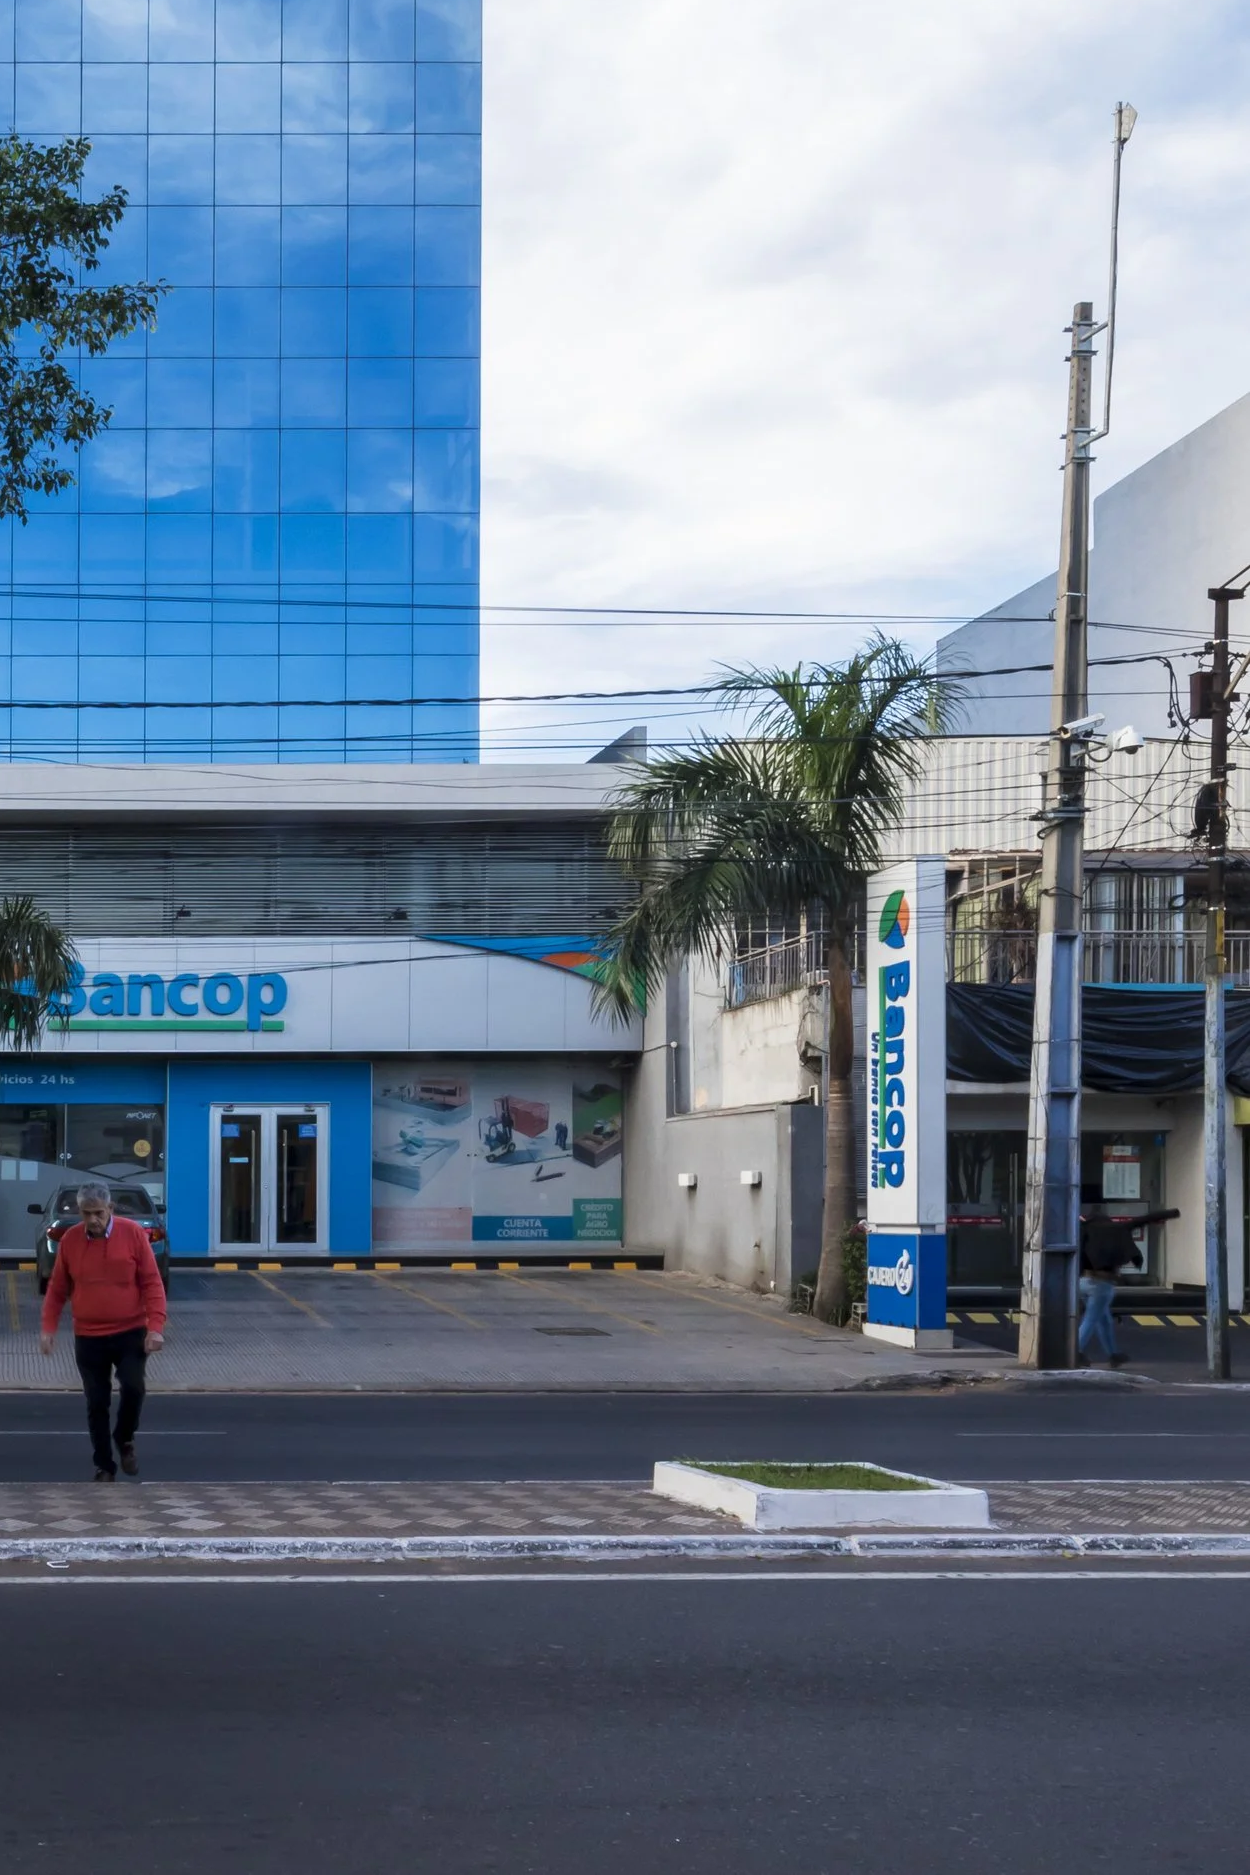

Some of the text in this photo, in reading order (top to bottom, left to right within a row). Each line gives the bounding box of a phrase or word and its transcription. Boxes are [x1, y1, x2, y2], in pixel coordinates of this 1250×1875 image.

[47, 961, 288, 1031] Bancop
[40, 1074, 56, 1084] 24
[60, 1074, 75, 1084] hs
[878, 959, 911, 1189] Bancop
[586, 1212, 608, 1220] PARA
[503, 1218, 542, 1228] CUENTA
[496, 1228, 549, 1238] CORRIENTE
[867, 1266, 896, 1287] CAJERO
